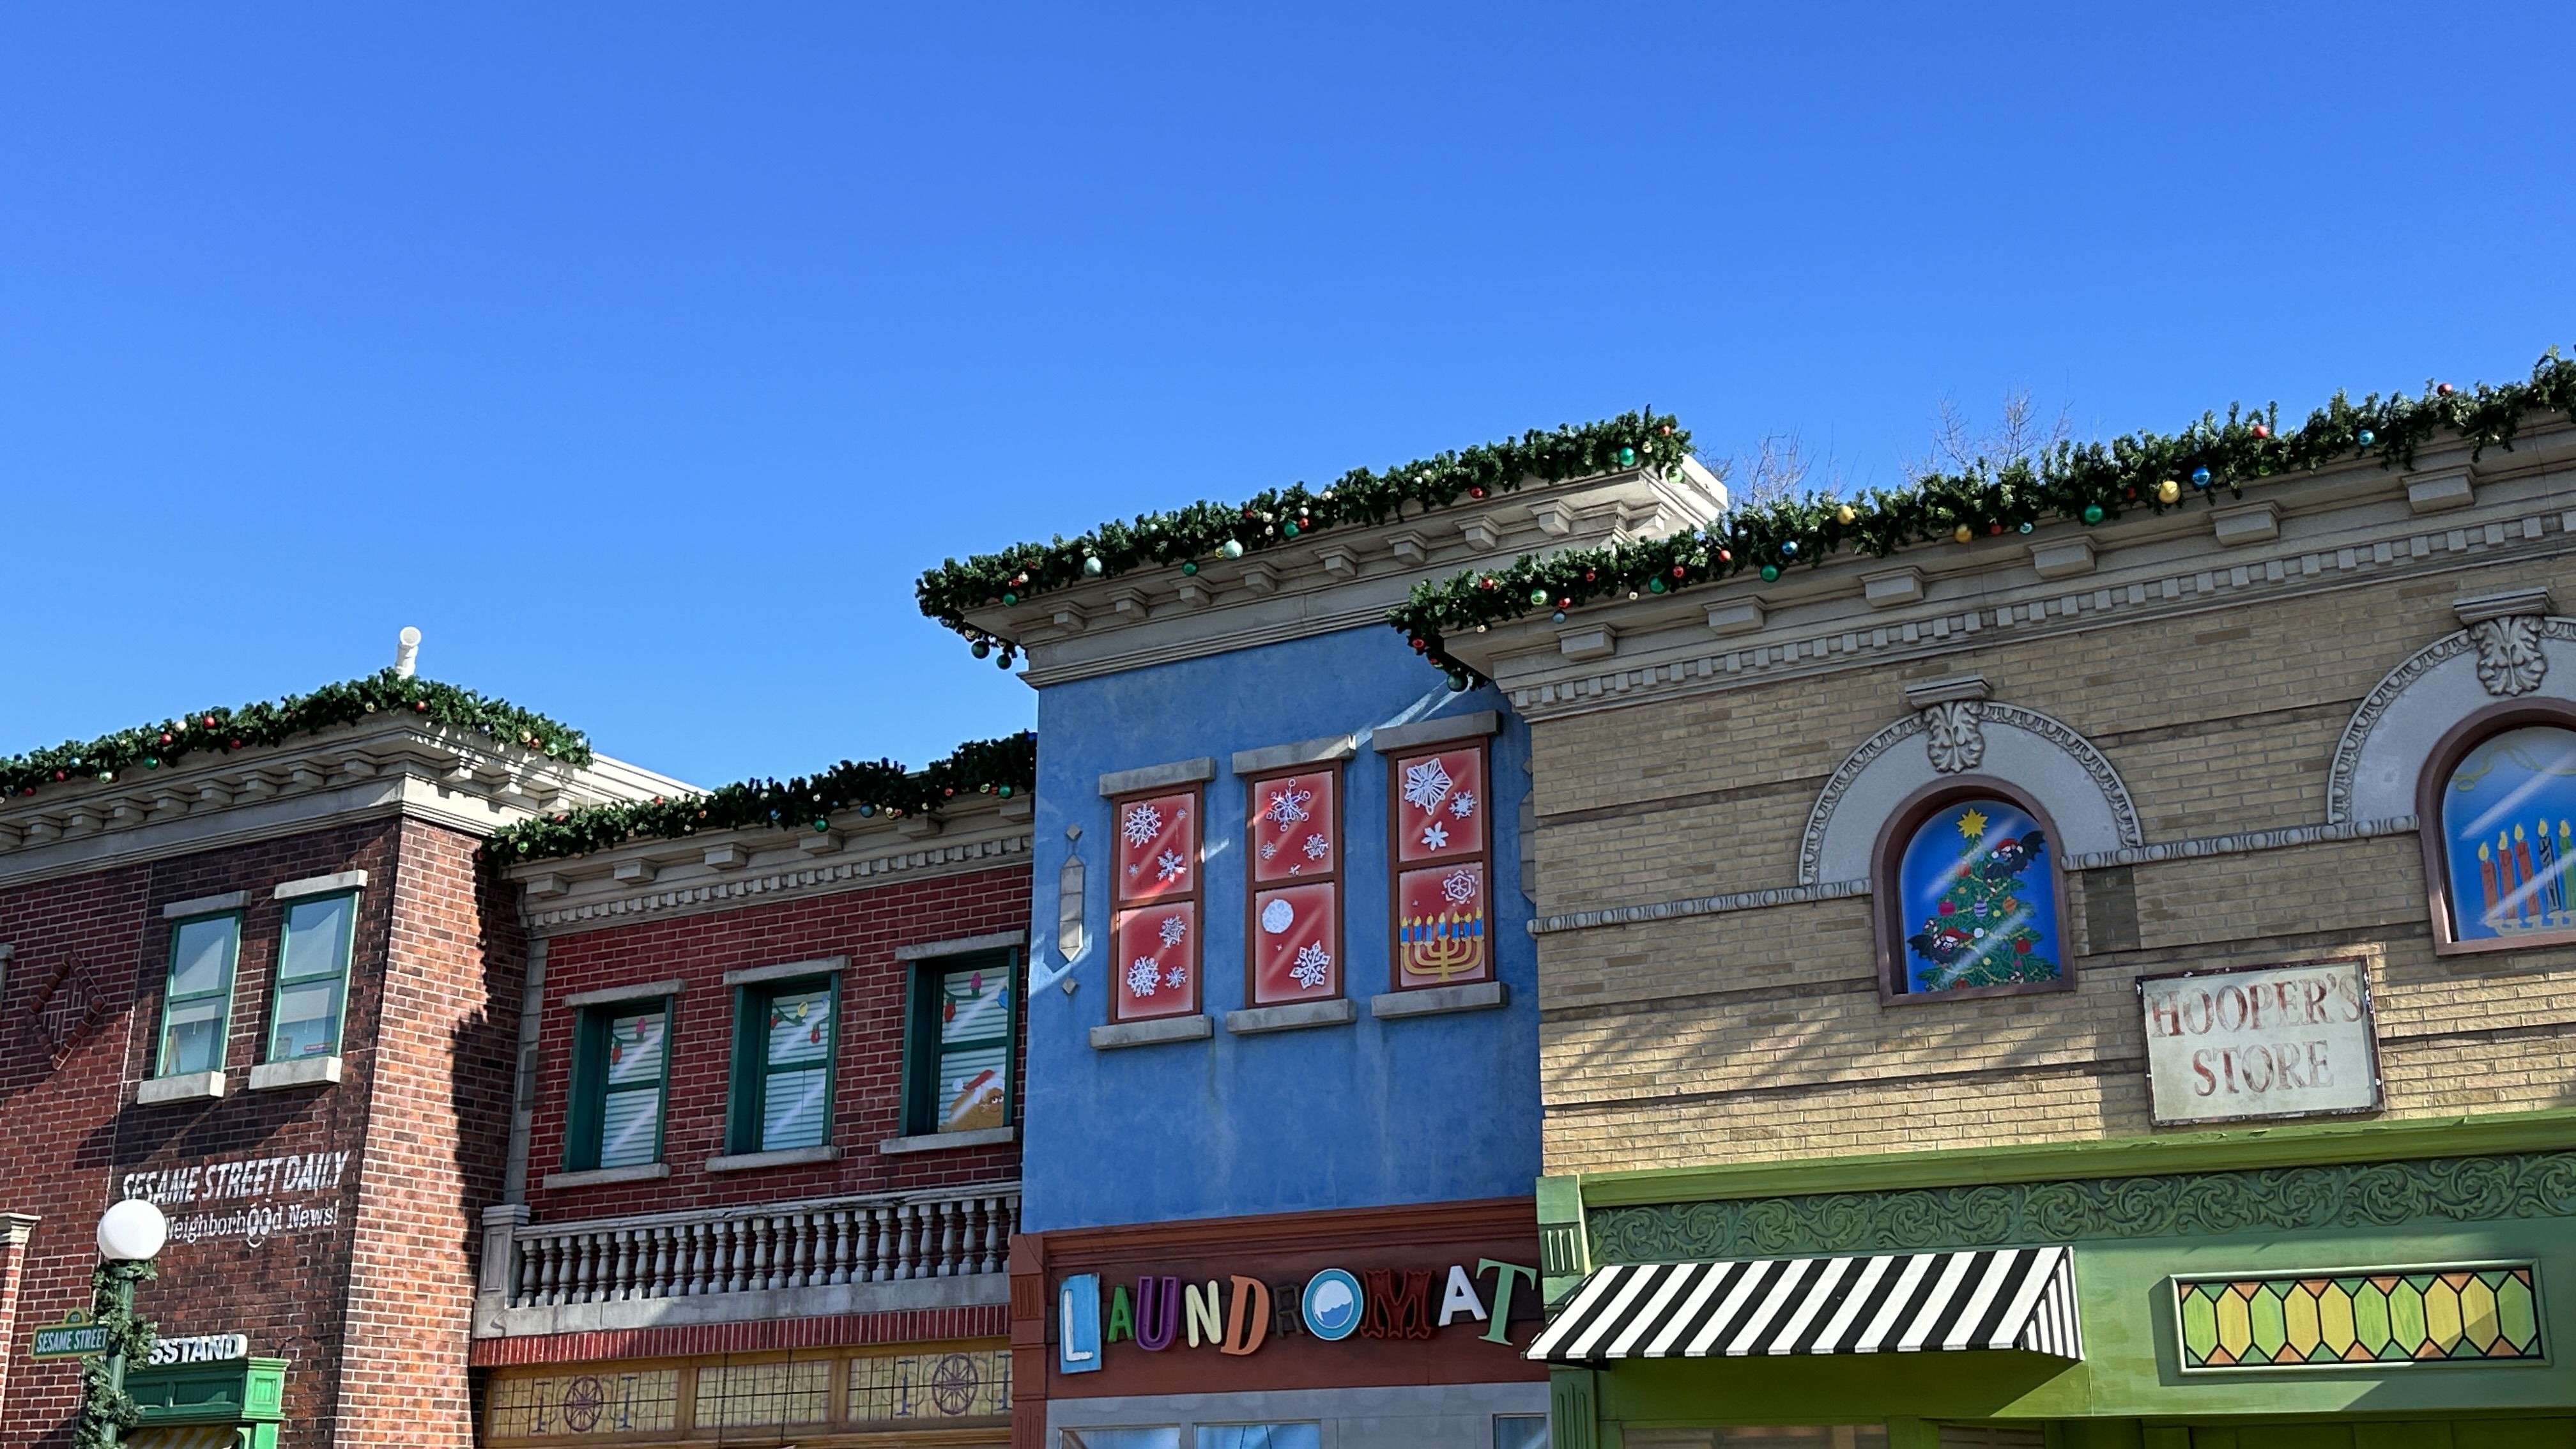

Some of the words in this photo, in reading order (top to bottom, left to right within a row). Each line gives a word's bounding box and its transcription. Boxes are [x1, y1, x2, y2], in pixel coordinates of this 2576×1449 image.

[2147, 972, 2364, 1038] HOOPER'S
[2191, 1039, 2334, 1097] STORE
[123, 1166, 202, 1205] SESAME
[201, 1156, 284, 1202] STREET
[282, 1150, 351, 1193] DAILY
[287, 1199, 341, 1229] News!
[36, 1330, 73, 1353] SESAME
[73, 1328, 109, 1350] STREET
[1060, 1257, 1538, 1374] LAUNDROMAT
[148, 1333, 240, 1365] SSTAND
